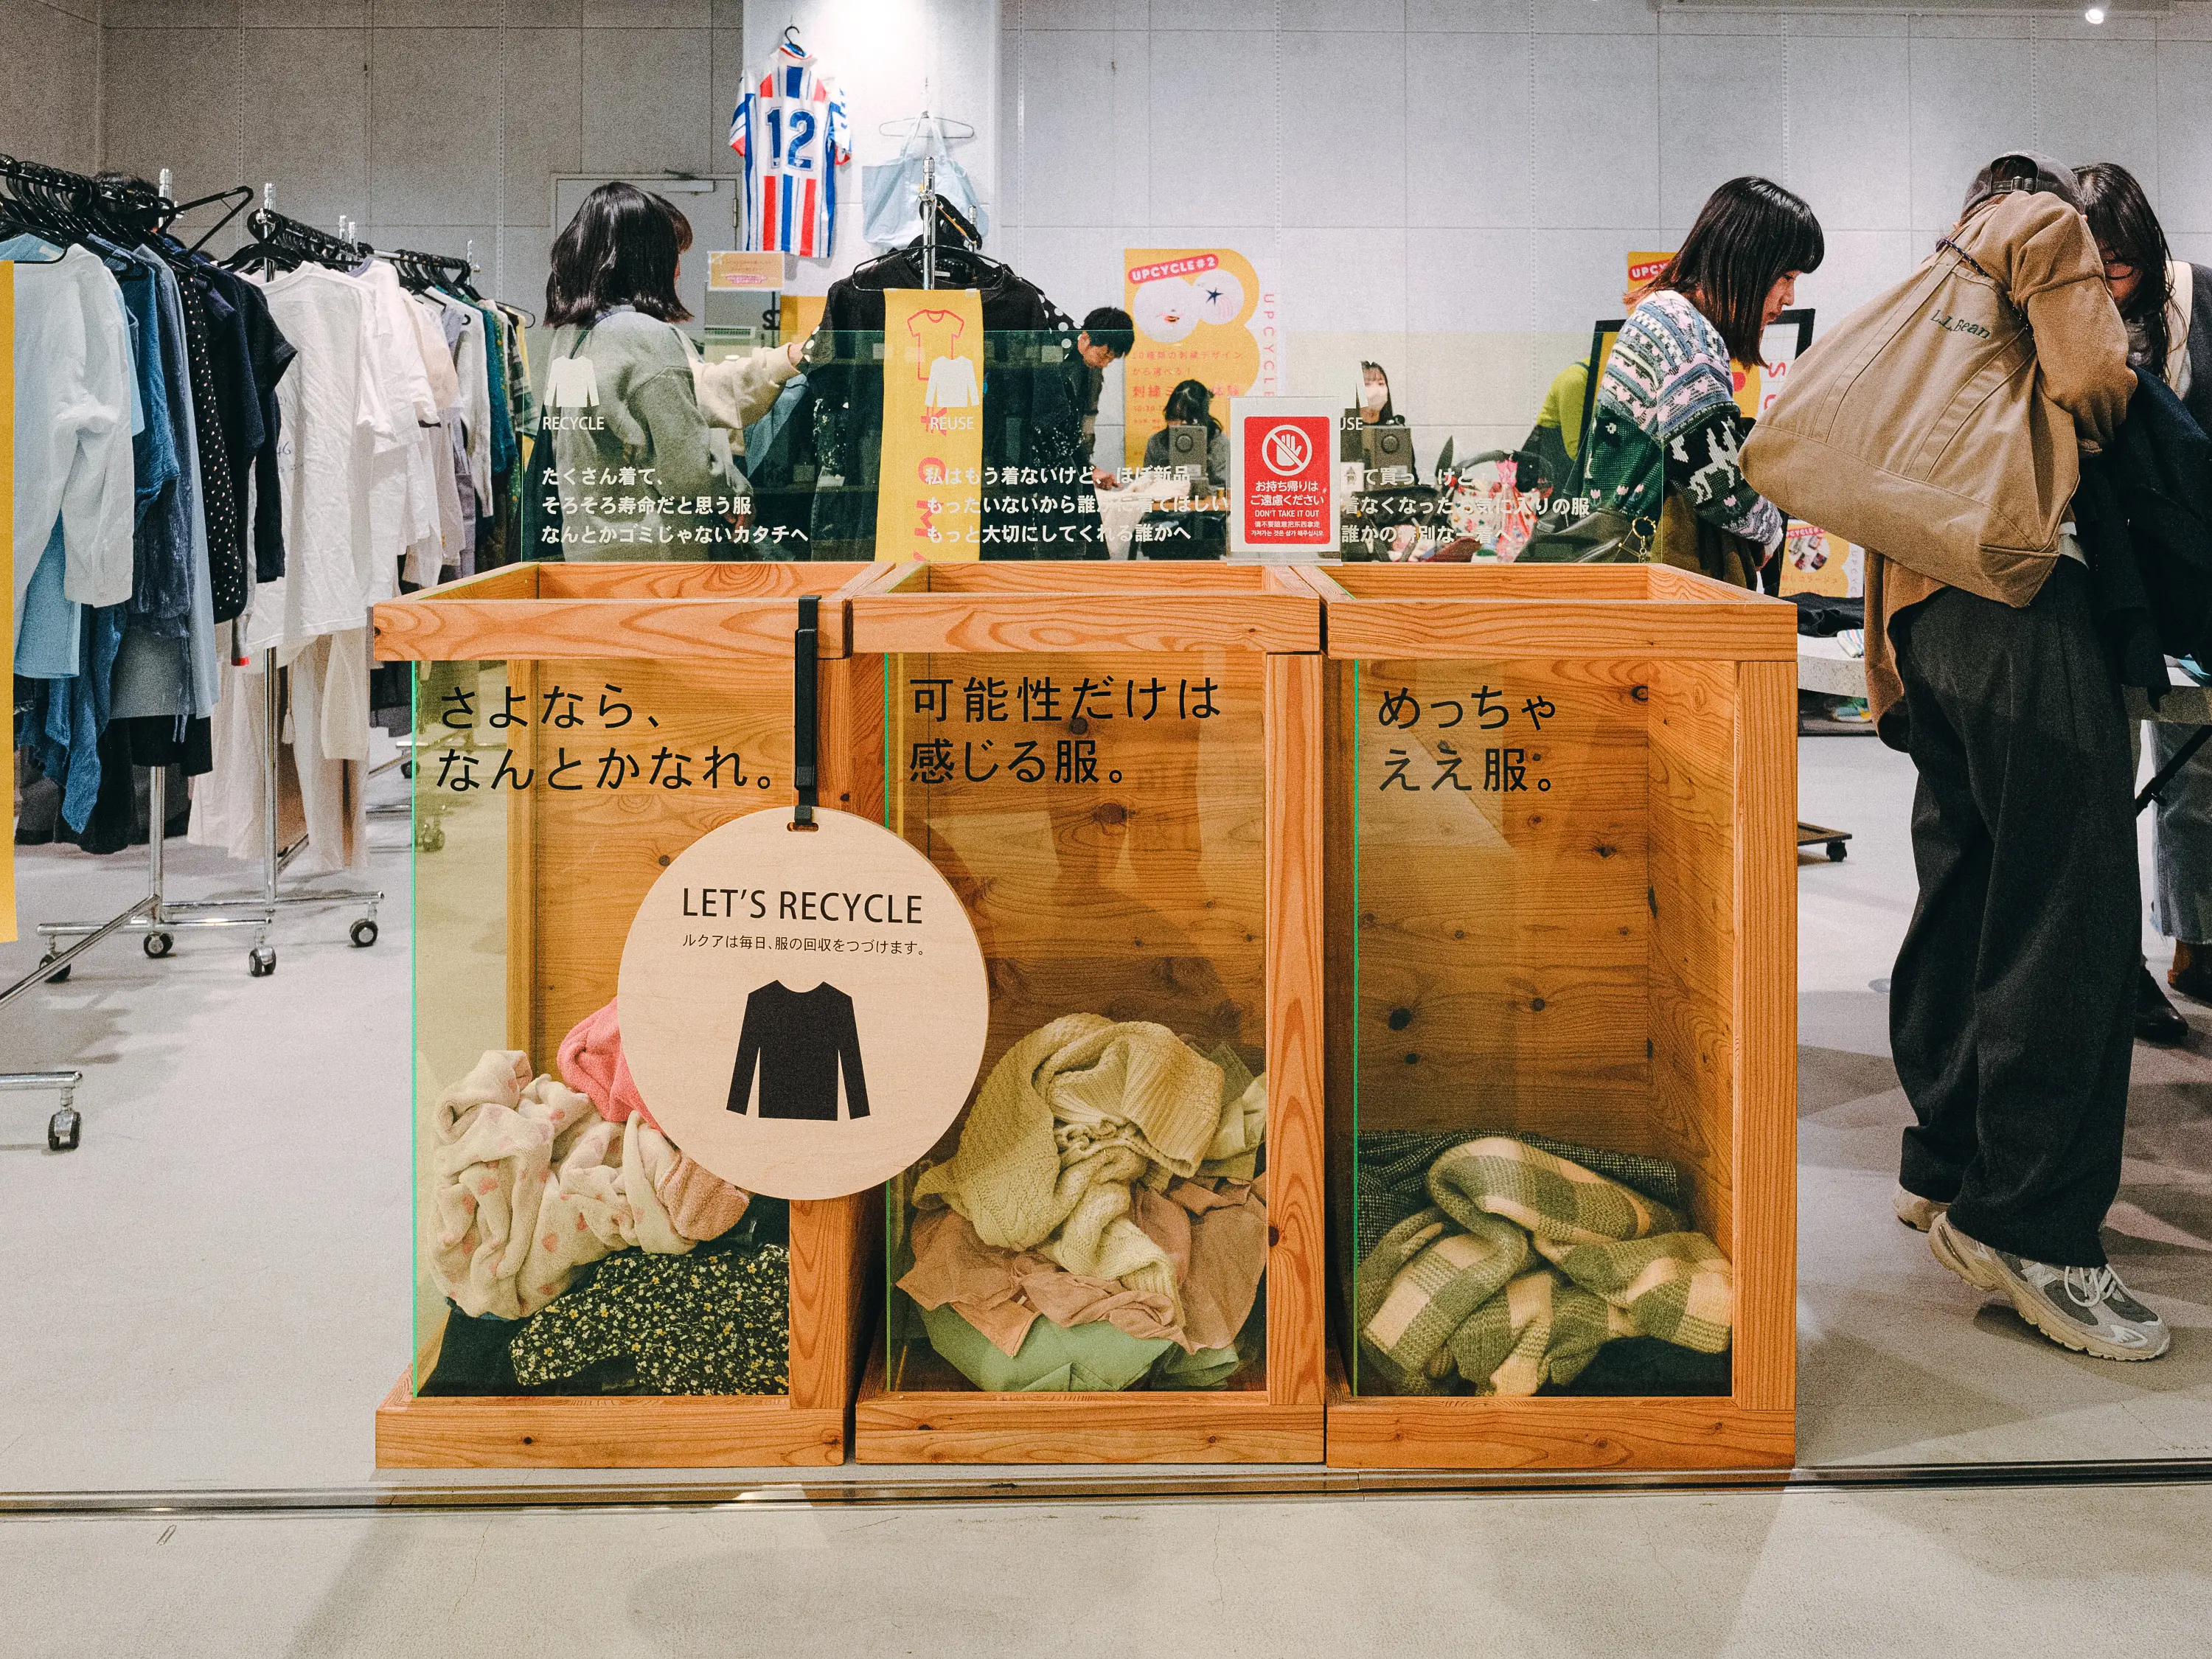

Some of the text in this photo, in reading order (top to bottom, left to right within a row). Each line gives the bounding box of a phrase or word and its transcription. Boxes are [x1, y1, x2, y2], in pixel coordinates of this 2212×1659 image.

[765, 106, 817, 171] 12
[1131, 257, 1216, 281] UPCYCLE#2
[1930, 310, 1990, 339] L.L.Bean
[543, 416, 605, 431] RECYCLE
[930, 417, 974, 431] REUSE
[543, 467, 663, 486] たくさん着て、
[1256, 481, 1318, 492] お持ち帰りは
[542, 495, 752, 515] そろそろ寿命だと思う服
[1251, 494, 1324, 506] ご遠慮ください
[541, 526, 809, 545] なんとかゴミじゃないカタチへ
[926, 524, 1192, 543] もっと大切にしてくれる誰かへ
[440, 684, 660, 729] さよなら、
[910, 675, 1221, 723] 可能性だけは
[1379, 685, 1556, 731] めっちゃ
[436, 745, 771, 792] なんとかなれ。
[909, 738, 1123, 785] 感じる服。
[1379, 748, 1551, 793] ええ服。
[779, 890, 923, 925] RECYCLE
[683, 933, 924, 956] ルクアは毎日、服の回収をつづけます。
